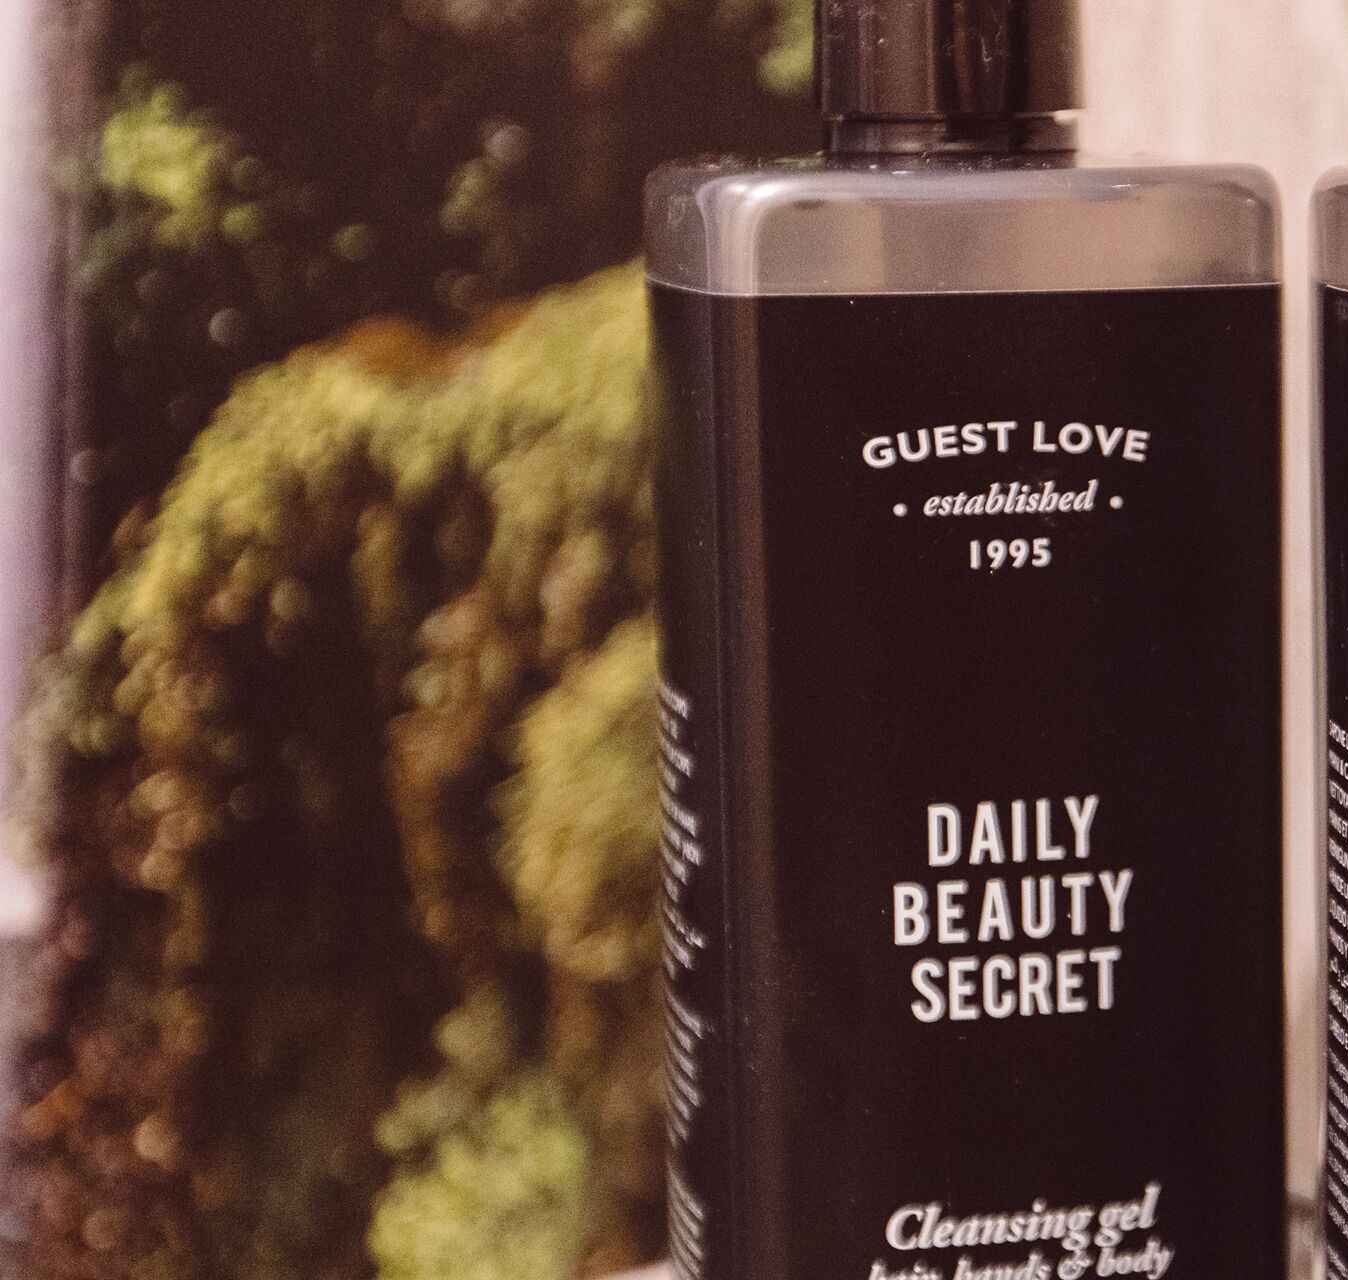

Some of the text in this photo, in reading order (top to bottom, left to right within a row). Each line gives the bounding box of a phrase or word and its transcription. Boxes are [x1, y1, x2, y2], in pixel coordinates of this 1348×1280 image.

[861, 419, 1151, 470] GUEST LOVE
[921, 480, 1099, 518] established
[968, 536, 1053, 570] 1995
[926, 793, 1101, 866] DAILY
[892, 868, 1135, 946] BEAUTY
[909, 946, 1123, 1024] SECRET
[885, 1181, 1162, 1251] Cleansing gel
[1058, 1251, 1092, 1280] &
